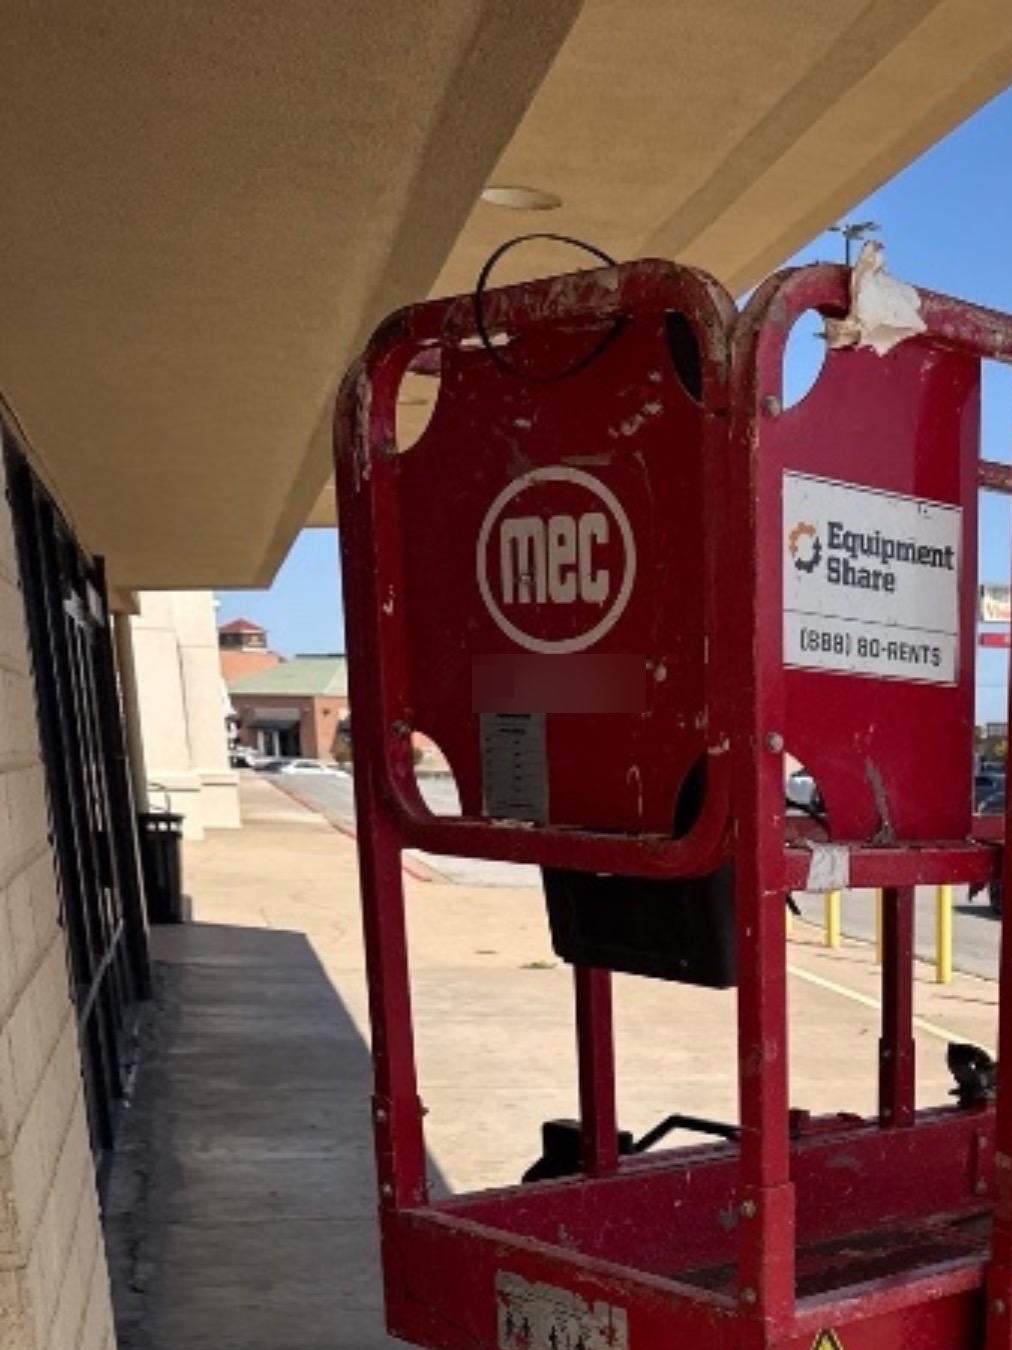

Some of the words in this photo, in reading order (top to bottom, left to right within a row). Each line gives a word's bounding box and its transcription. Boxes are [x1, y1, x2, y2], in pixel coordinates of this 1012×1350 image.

[827, 521, 955, 570] Equipment
[827, 557, 895, 593] Share
[800, 627, 850, 657] (888)
[857, 637, 942, 667] 80-RENTS
